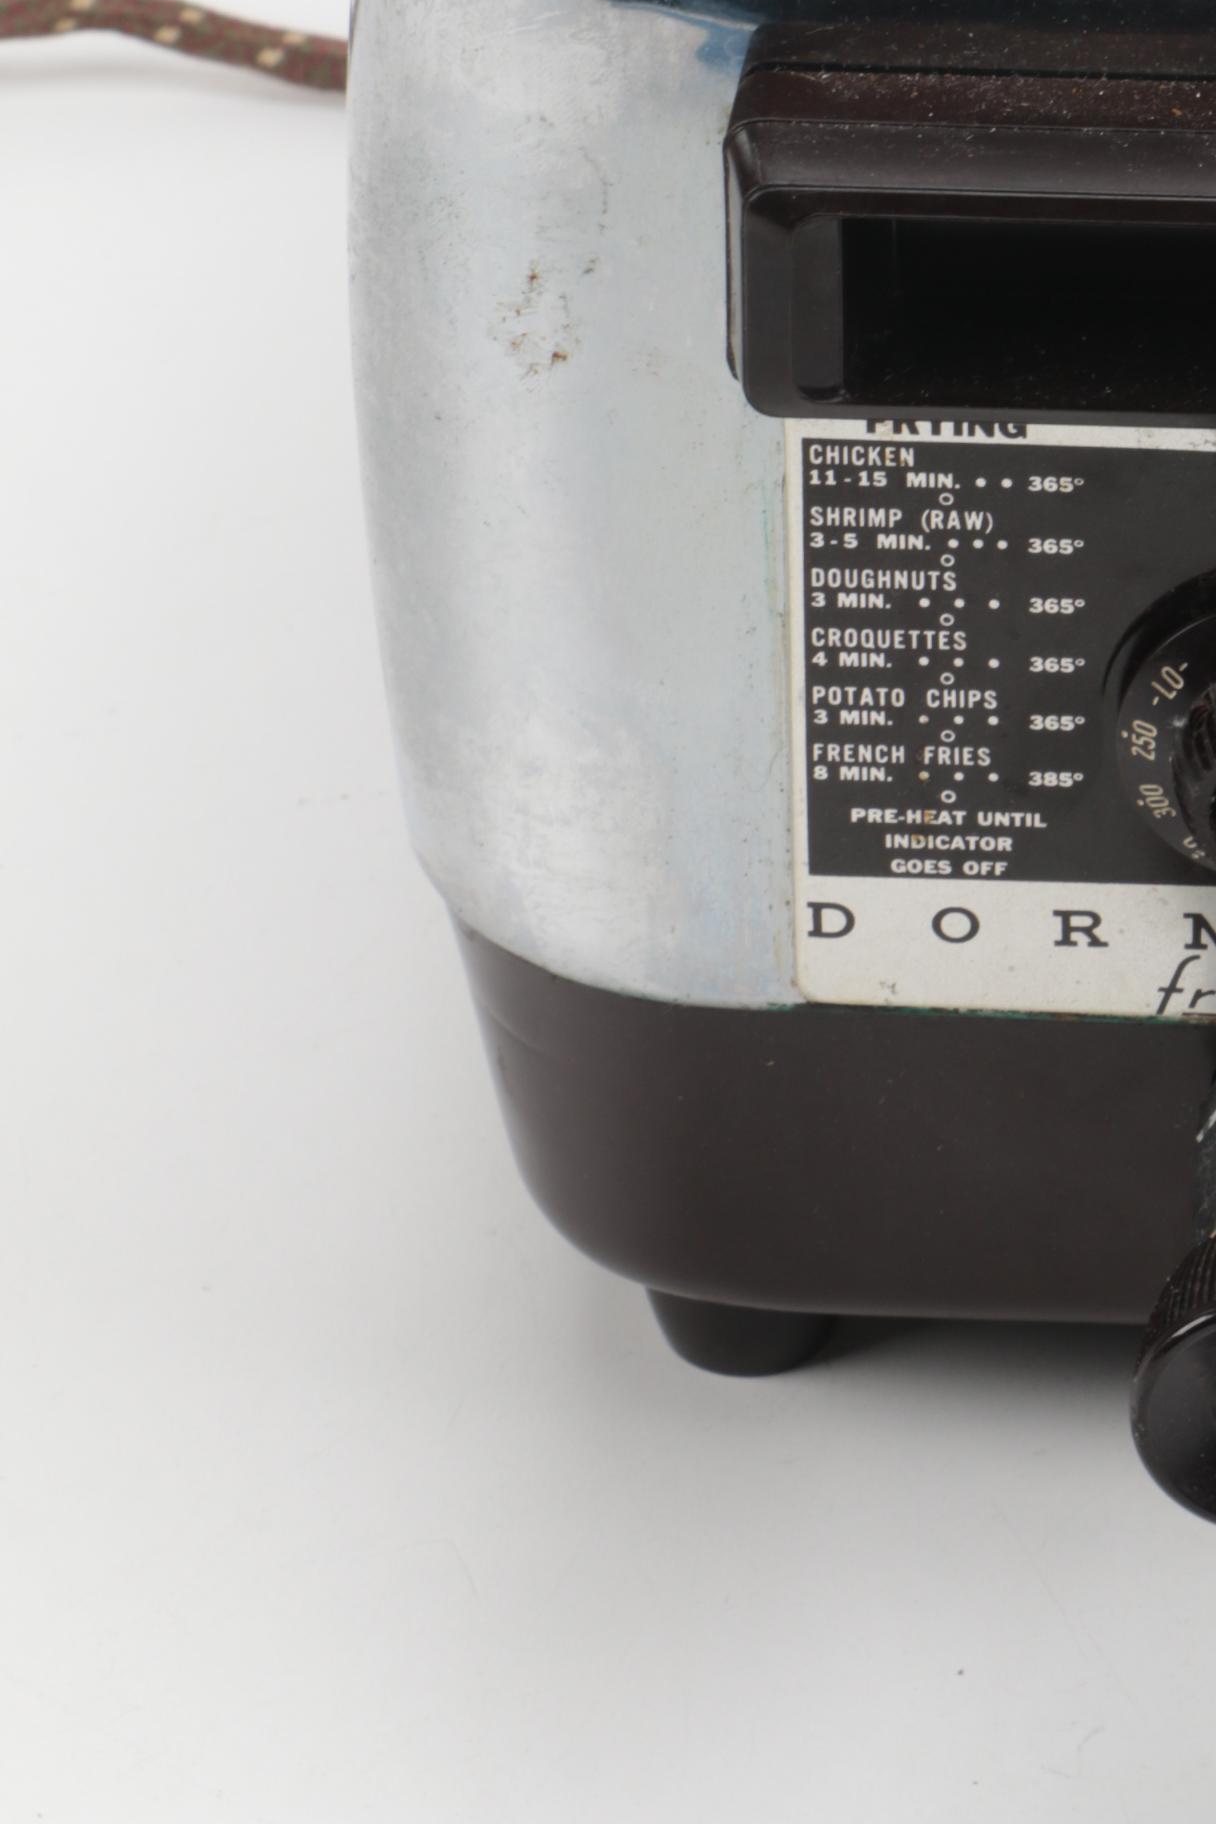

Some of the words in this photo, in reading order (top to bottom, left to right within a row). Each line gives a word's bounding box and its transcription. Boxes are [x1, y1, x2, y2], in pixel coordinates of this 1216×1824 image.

[810, 444, 914, 467] CHICKEN
[810, 469, 887, 487] 11-15
[907, 472, 960, 488] MIN.
[1028, 476, 1083, 492] 365°
[810, 506, 902, 528] SHRIMP
[922, 509, 993, 534] (RAW)
[810, 532, 858, 548] 3-5
[877, 534, 930, 550] MIN.
[1028, 538, 1084, 554] 365°
[811, 568, 956, 591] DOUGHNUTS
[811, 592, 826, 607] 3
[838, 592, 891, 609] MIN.
[1029, 598, 1085, 614] 365°
[812, 627, 966, 650] CROQUETTES
[812, 651, 827, 666] 4
[839, 652, 891, 667] MIN.
[1030, 657, 1085, 673] 365°
[812, 686, 904, 707] POTATO
[927, 689, 997, 709] CHIPS
[814, 709, 828, 724] 3
[840, 710, 893, 725] MIN.
[1030, 715, 1085, 731] 365°
[1131, 719, 1157, 760] 250
[813, 743, 904, 763] FRENCH
[924, 746, 990, 766] FRIES
[813, 765, 828, 780] 8
[840, 766, 892, 782] MIN.
[1029, 772, 1083, 787] 385°
[1139, 784, 1176, 819] 300
[851, 808, 966, 825] PRE-HEAT
[978, 812, 1046, 827] UNTIL
[885, 834, 1012, 851] INDICATOR
[891, 859, 952, 874] GOES
[963, 861, 1007, 876] OFF
